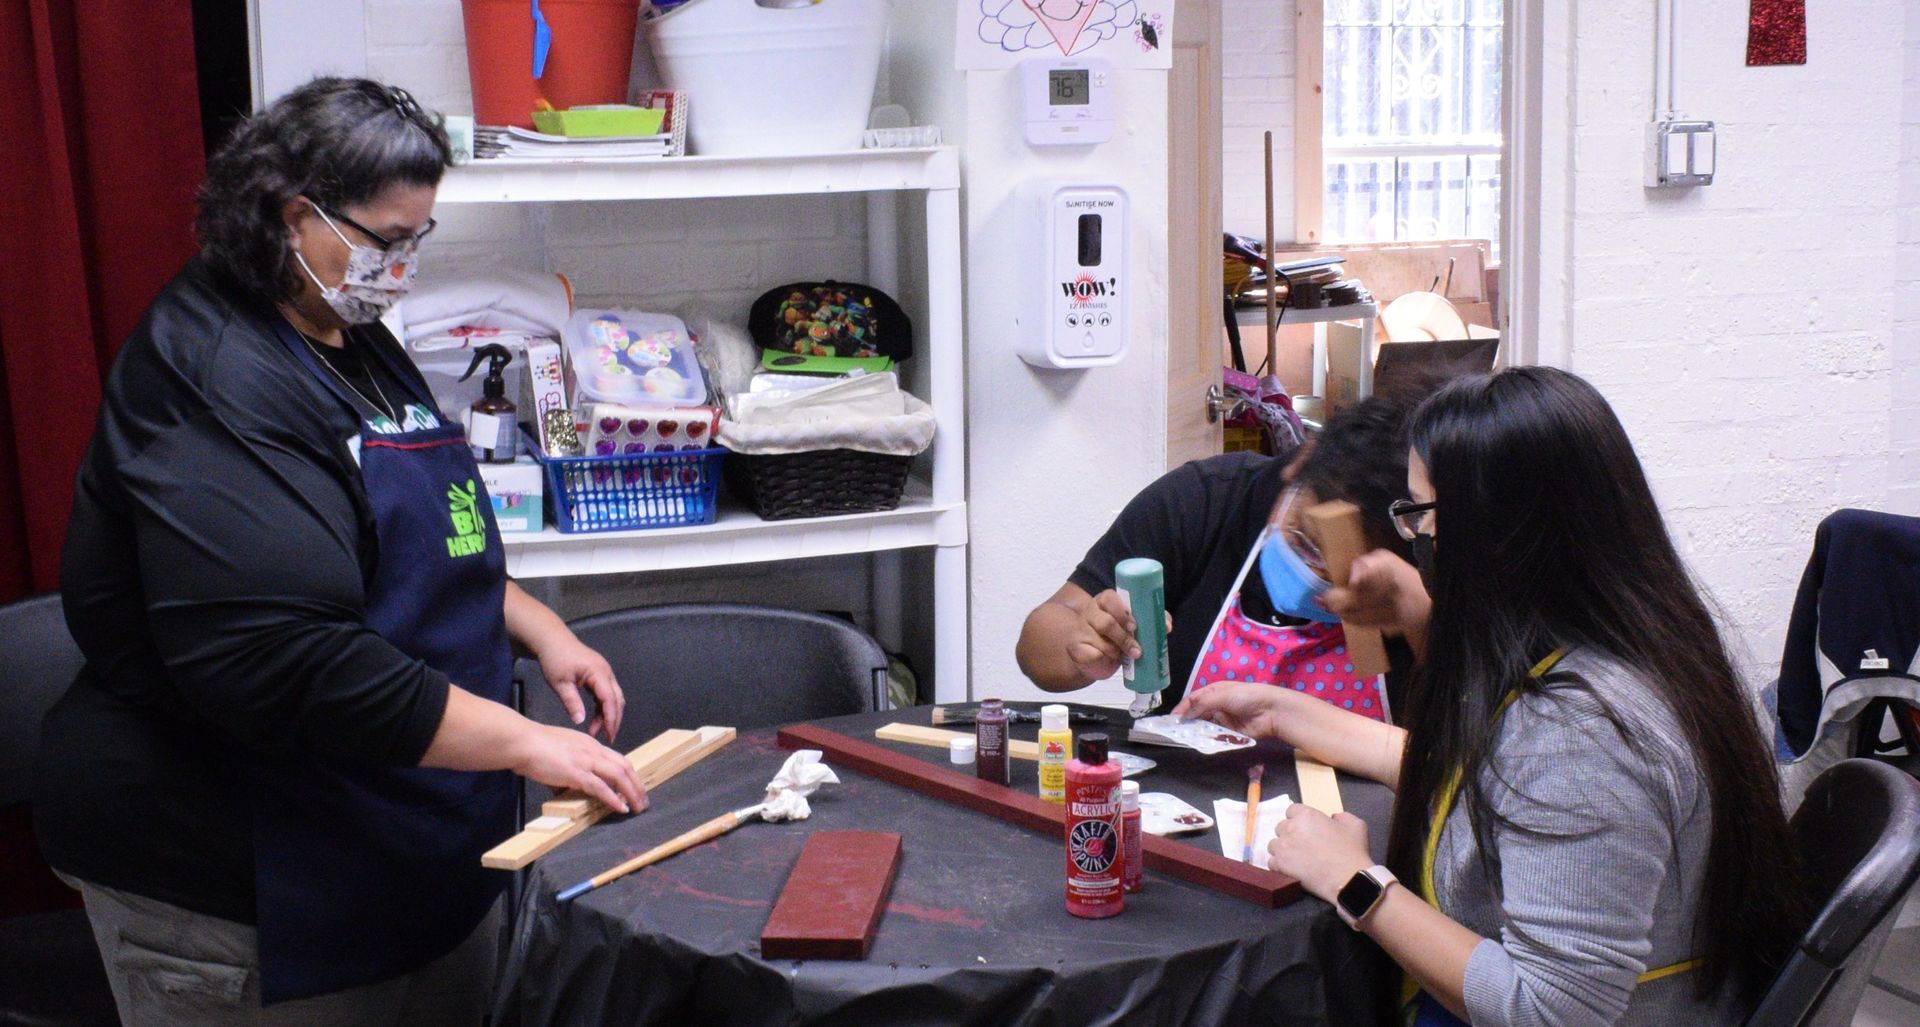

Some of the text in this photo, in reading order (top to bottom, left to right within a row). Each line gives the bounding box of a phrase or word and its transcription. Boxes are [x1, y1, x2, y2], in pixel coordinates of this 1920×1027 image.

[1061, 277, 1116, 297] WOW!
[1074, 803, 1113, 816] ACRYLIC
[1071, 821, 1105, 851] CRAFT
[1075, 851, 1110, 872] PAINT
